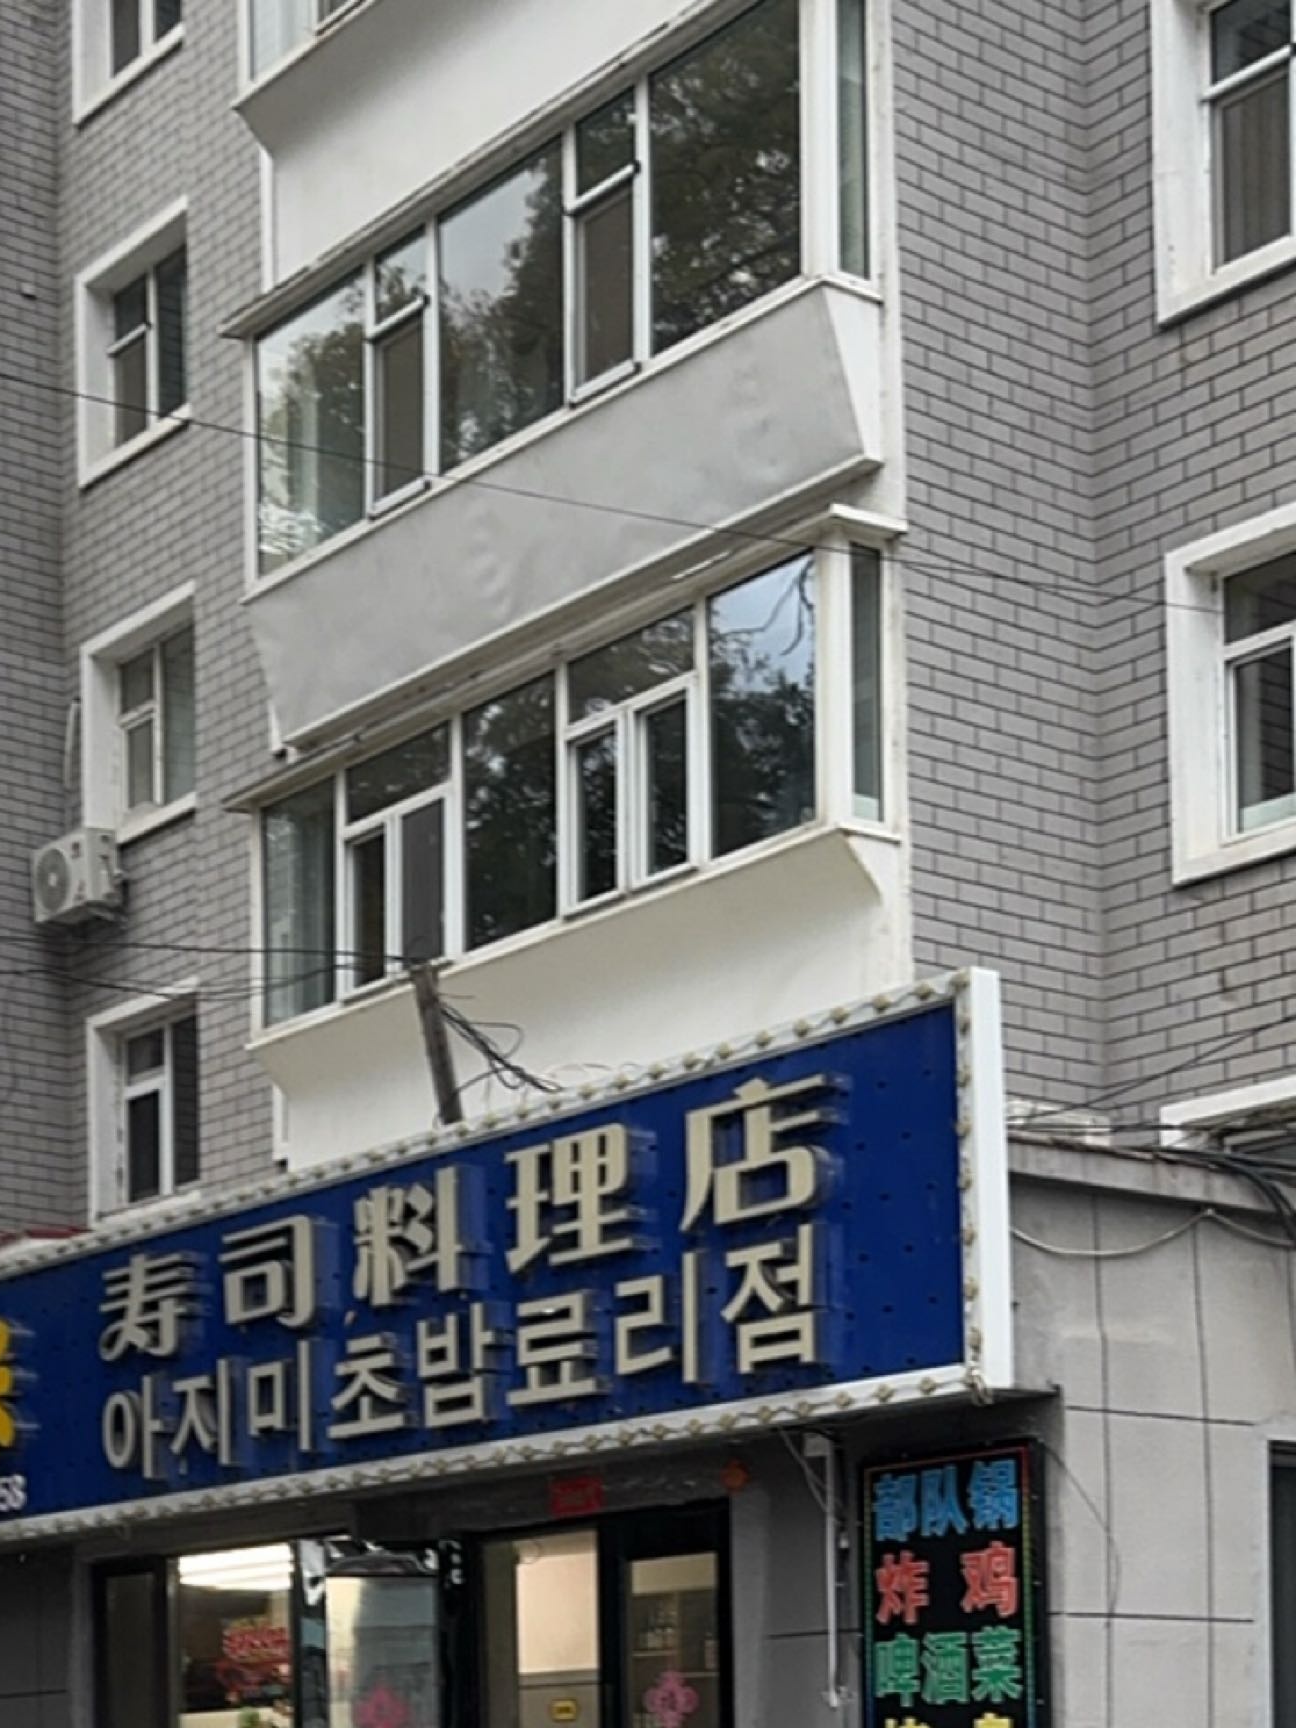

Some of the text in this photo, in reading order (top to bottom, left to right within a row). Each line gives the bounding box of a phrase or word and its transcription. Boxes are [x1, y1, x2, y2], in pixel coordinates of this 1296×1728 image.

[99, 1076, 833, 1362] 寿司料理店
[102, 1223, 818, 1480] 아지미초밥료리점
[872, 1458, 1020, 1542] 部队锅
[874, 1540, 1019, 1625] 炸鸡
[874, 1625, 1023, 1707] 啤酒菜
